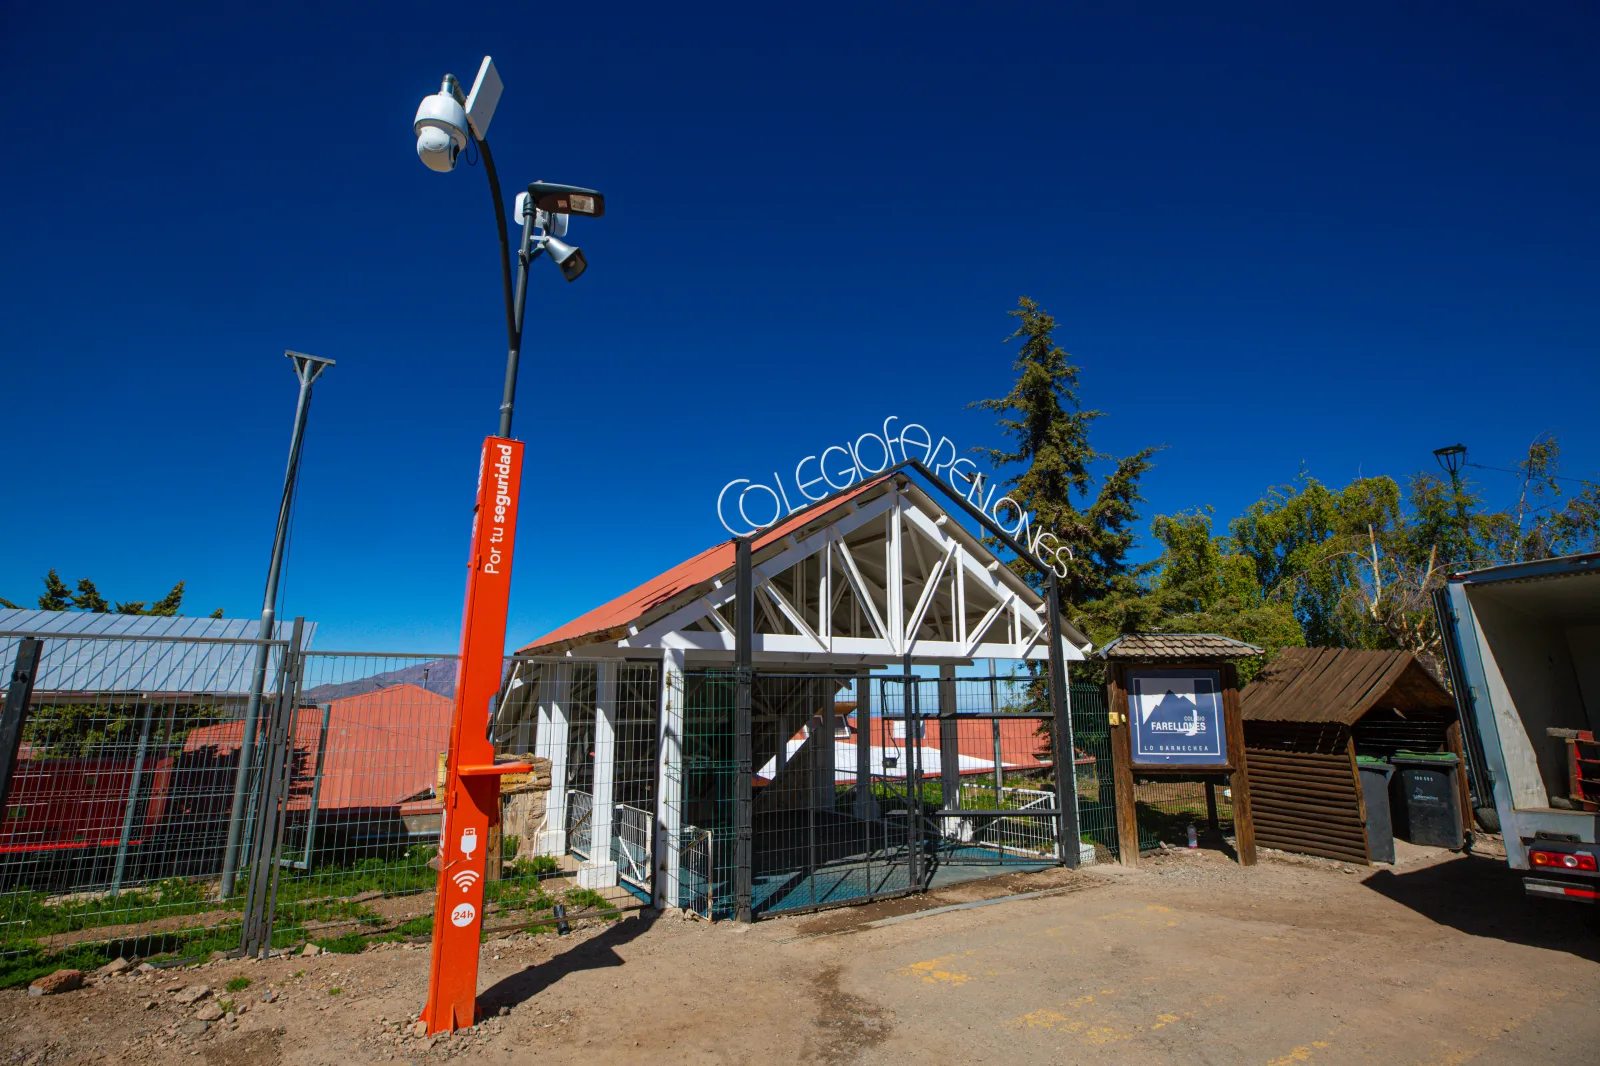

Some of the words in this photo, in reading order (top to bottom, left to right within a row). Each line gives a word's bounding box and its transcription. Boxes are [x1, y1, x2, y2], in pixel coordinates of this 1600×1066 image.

[494, 444, 512, 523] seguridad
[717, 433, 889, 537] COLEGIO
[489, 527, 504, 543] tu
[484, 547, 502, 574] Por
[453, 911, 473, 920] 24h
